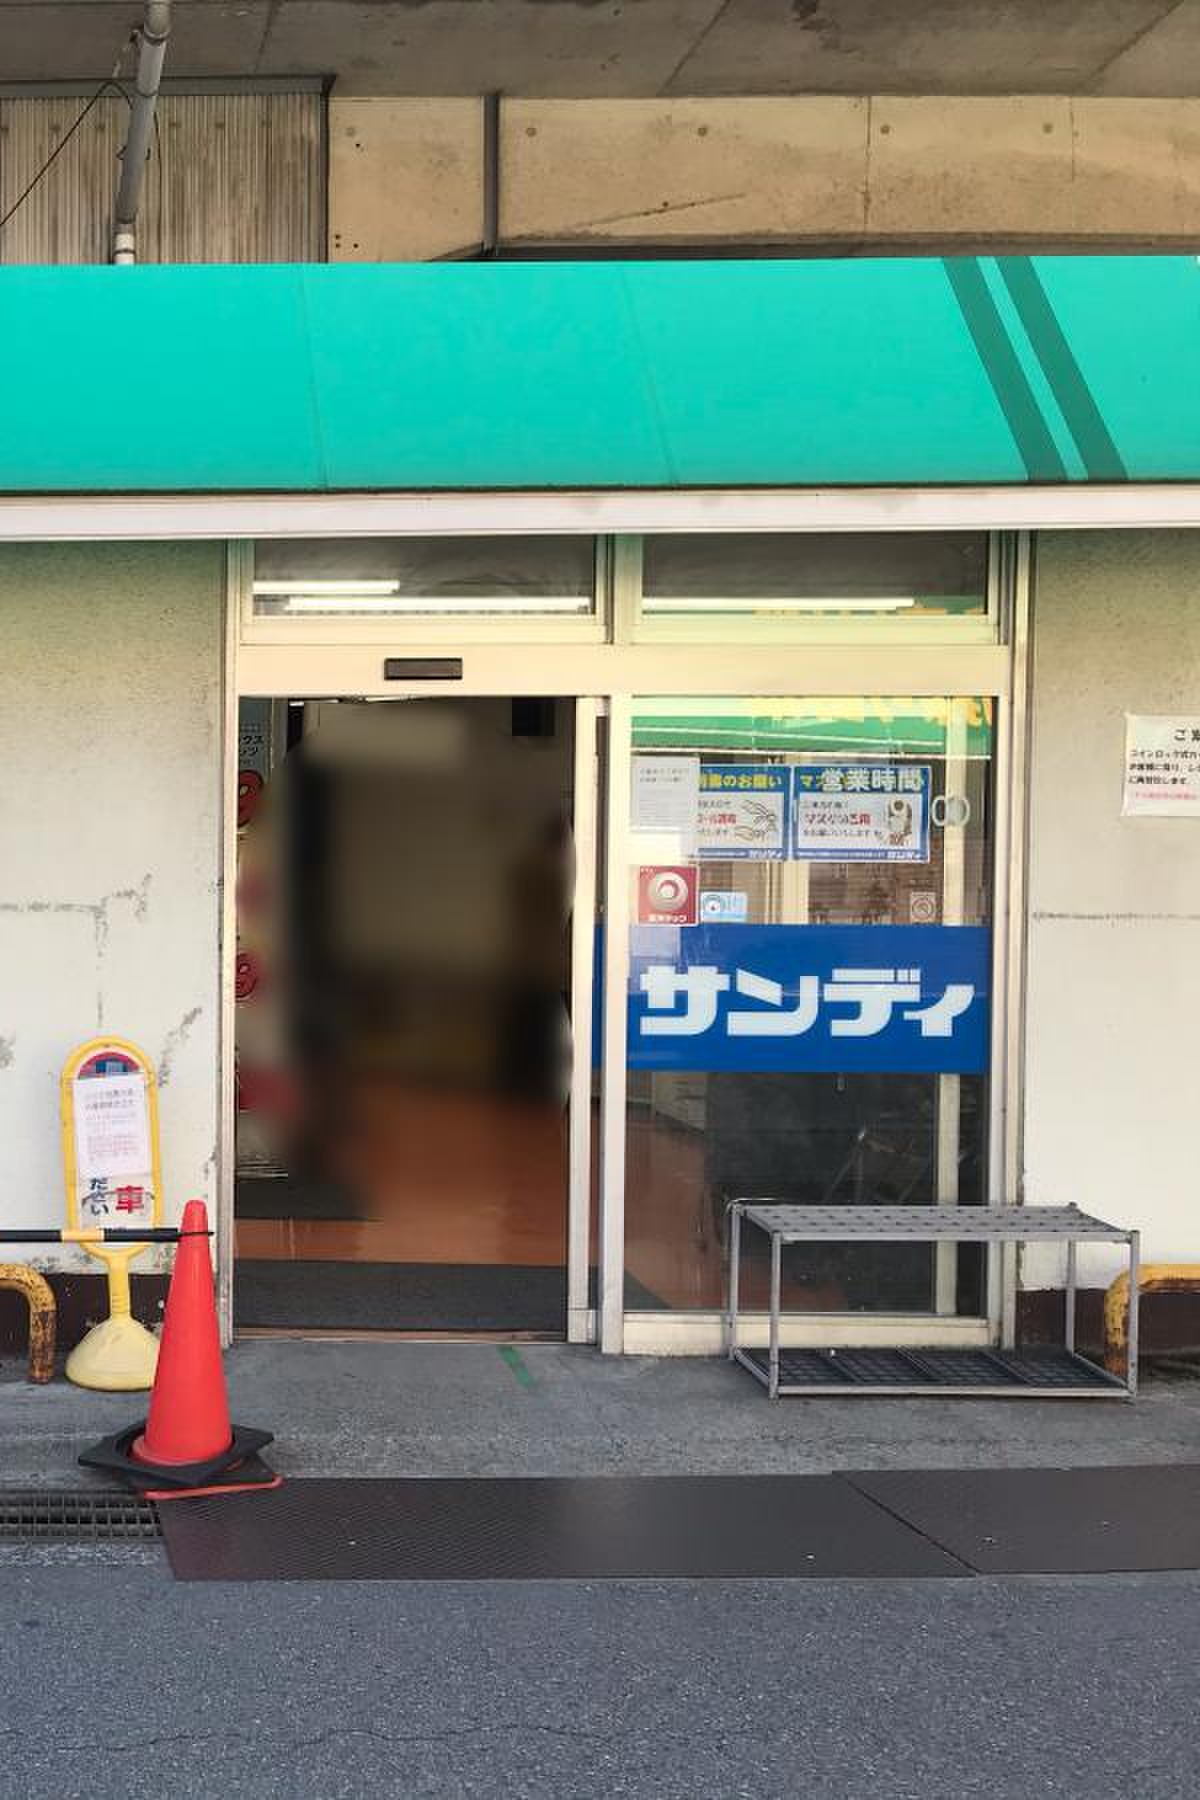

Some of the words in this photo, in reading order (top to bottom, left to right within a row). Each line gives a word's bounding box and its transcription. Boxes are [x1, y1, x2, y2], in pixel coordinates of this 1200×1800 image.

[822, 767, 922, 792] 営業時間
[639, 965, 976, 1037] サンディ
[115, 1185, 144, 1214] 車
